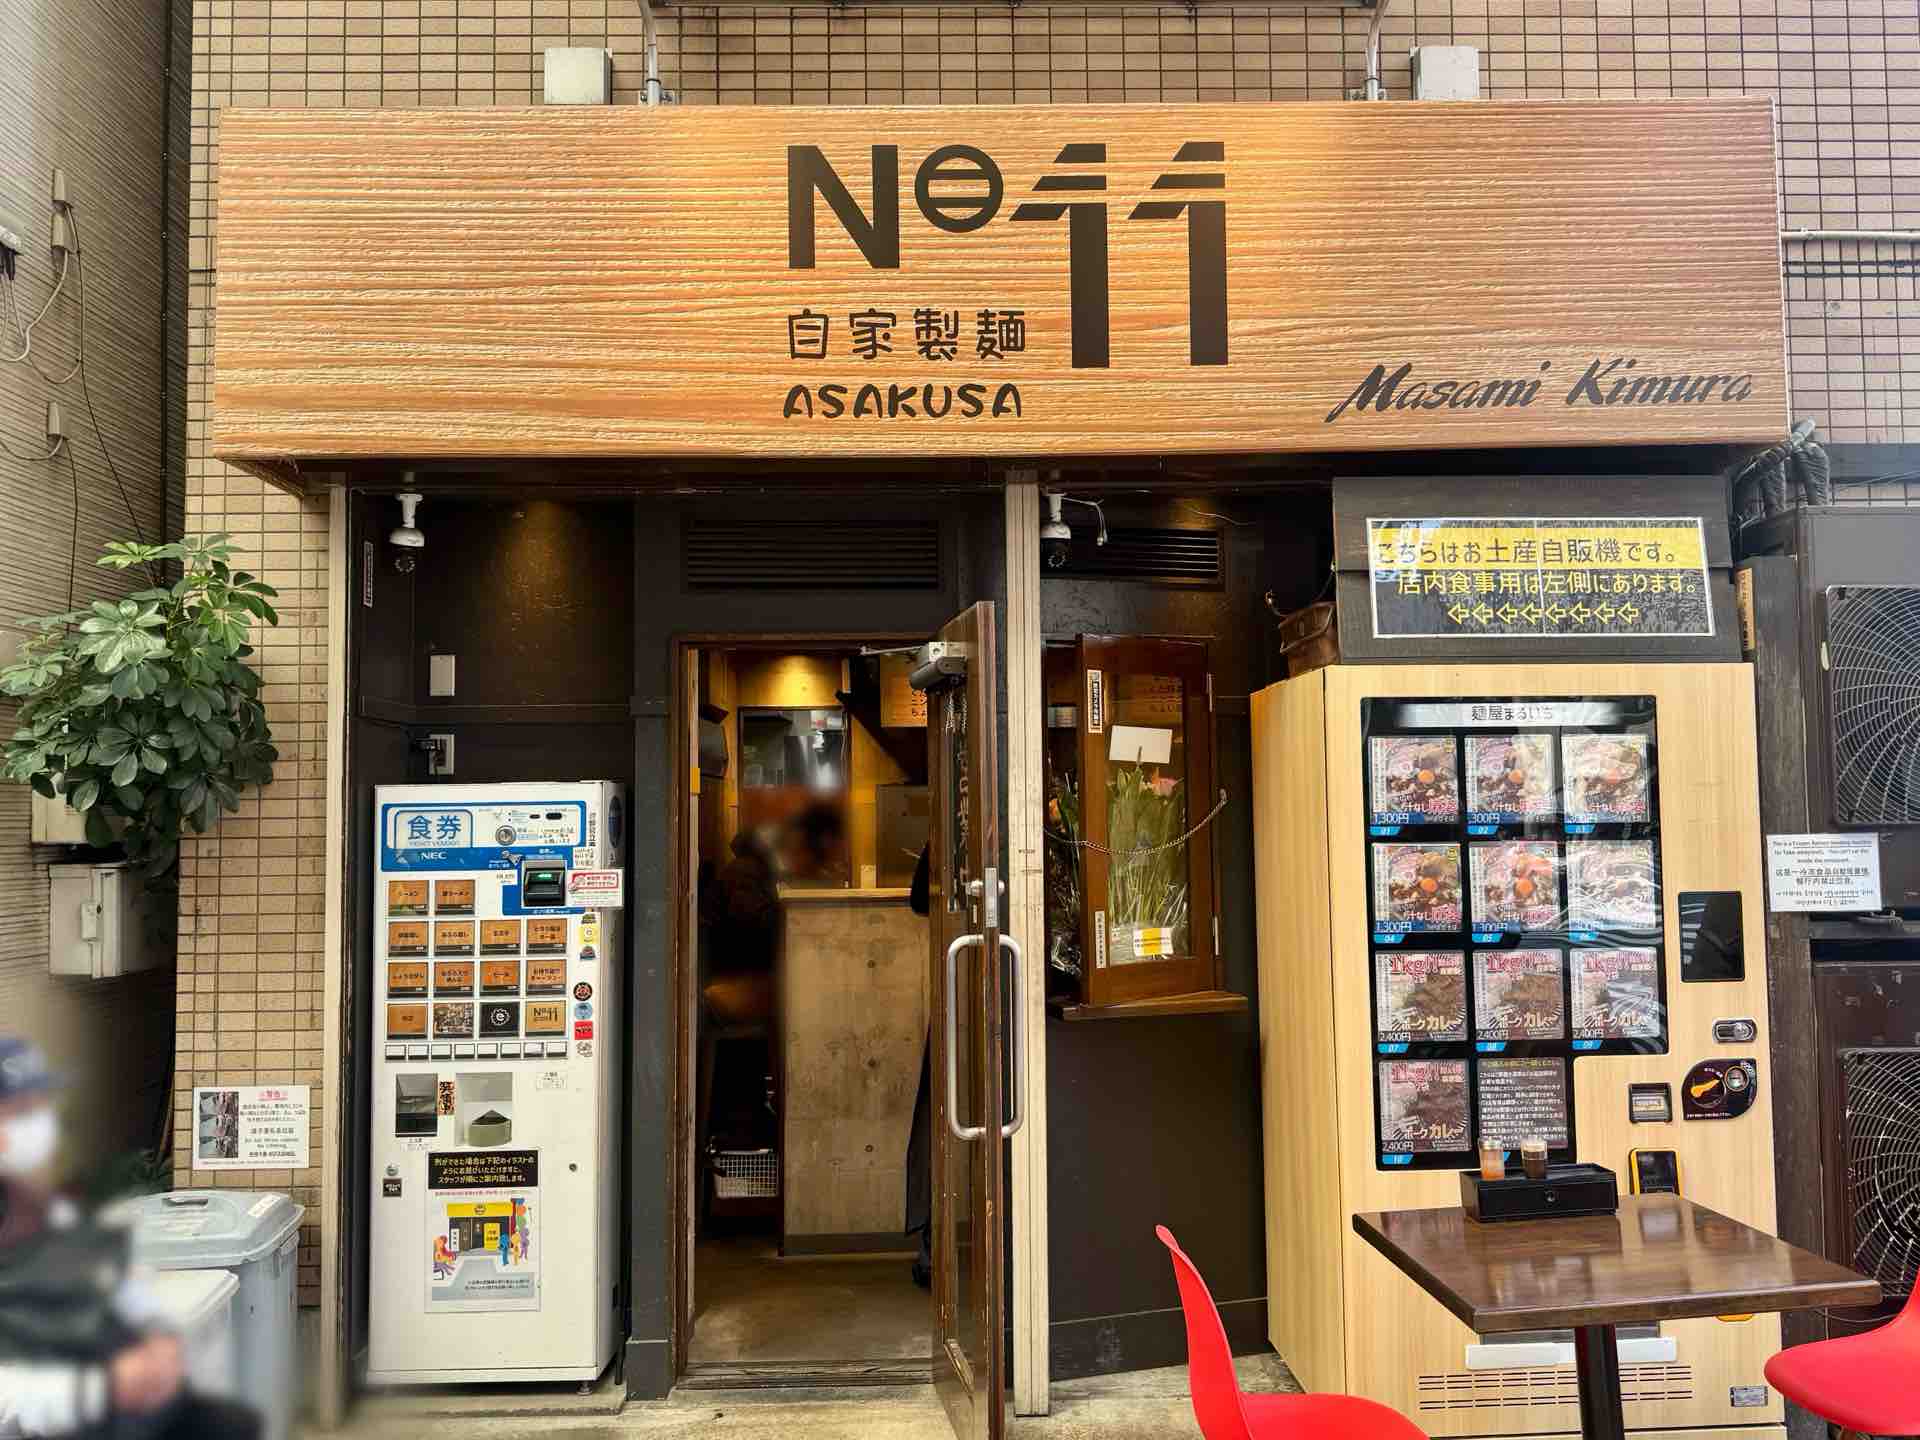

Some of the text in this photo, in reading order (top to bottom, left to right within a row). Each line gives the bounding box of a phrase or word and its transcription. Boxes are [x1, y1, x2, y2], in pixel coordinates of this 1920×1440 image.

[789, 308, 1026, 360] 自家製麺
[783, 383, 1022, 419] ASAKUSA
[1324, 358, 1752, 423] Masami Kimura
[1375, 538, 1676, 564] こちらはお土産自販機です。
[1398, 572, 1697, 595] 店内食事用は左側にあります。
[408, 815, 462, 841] 食券
[421, 851, 447, 860] NEC
